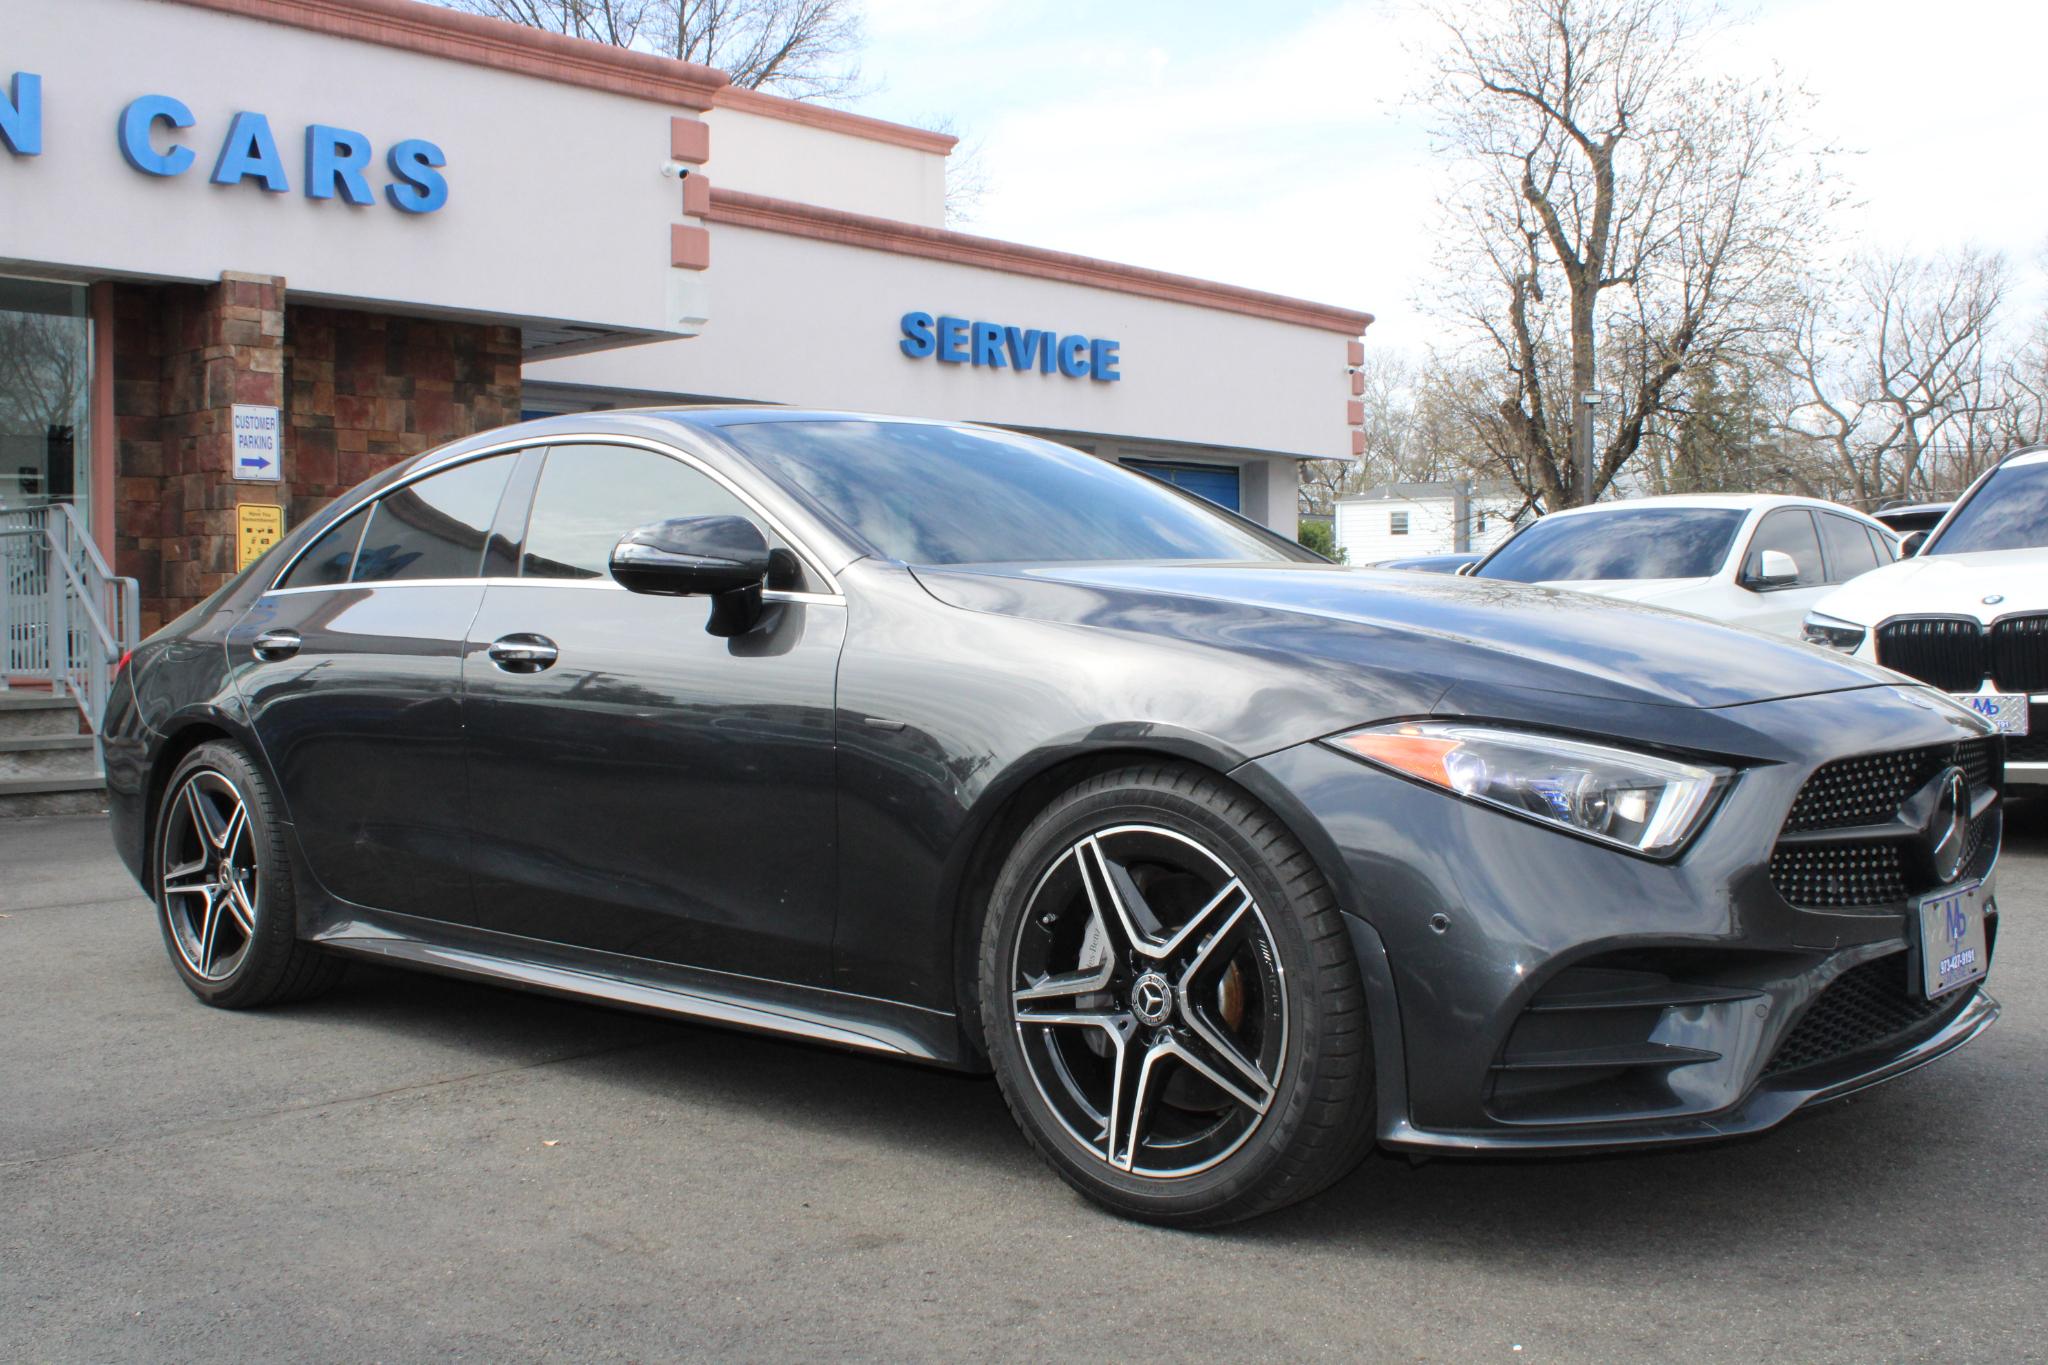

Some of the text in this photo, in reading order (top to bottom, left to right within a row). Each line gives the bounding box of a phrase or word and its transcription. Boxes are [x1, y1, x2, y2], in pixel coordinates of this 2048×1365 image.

[118, 94, 449, 213] CARS
[900, 311, 1121, 381] SERVICE
[235, 415, 275, 430] CUSTOMER
[239, 434, 273, 449] PARKING
[1940, 949, 1975, 975] 973-427-9191
